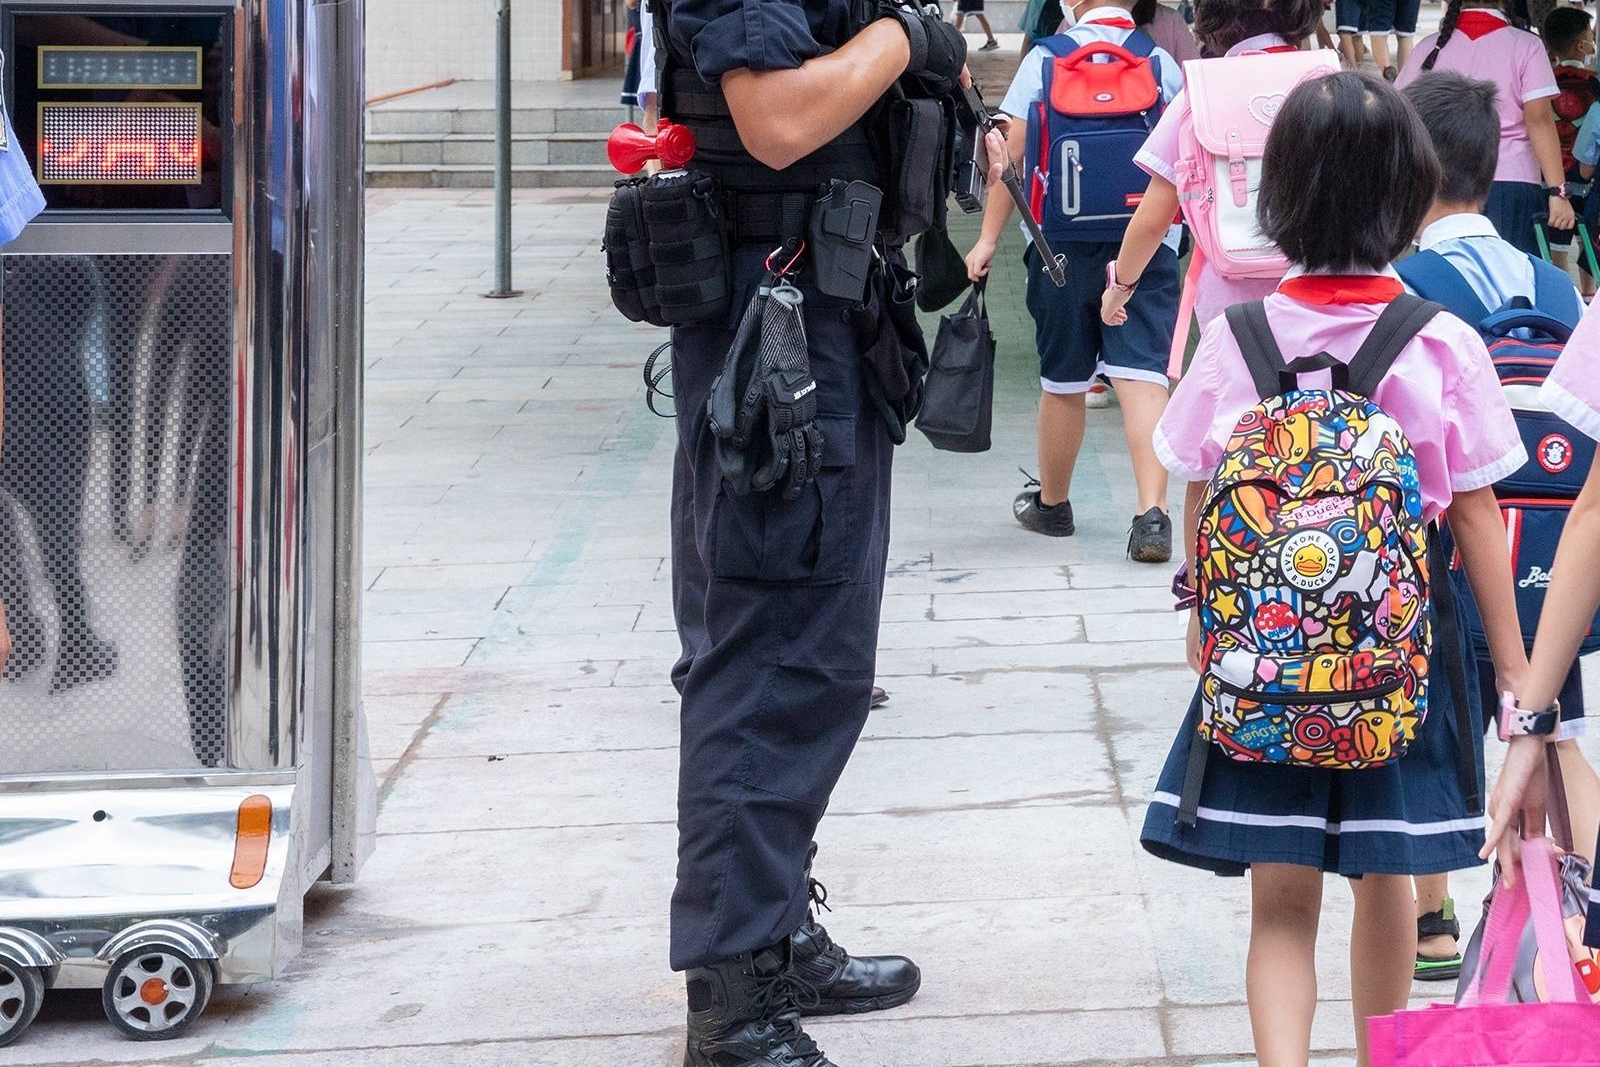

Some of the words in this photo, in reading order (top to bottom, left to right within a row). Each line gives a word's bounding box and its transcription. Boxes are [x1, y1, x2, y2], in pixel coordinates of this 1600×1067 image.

[1284, 534, 1321, 573] EVERYONE
[1322, 541, 1337, 575] LOVES
[1290, 574, 1328, 588] B.DUCK
